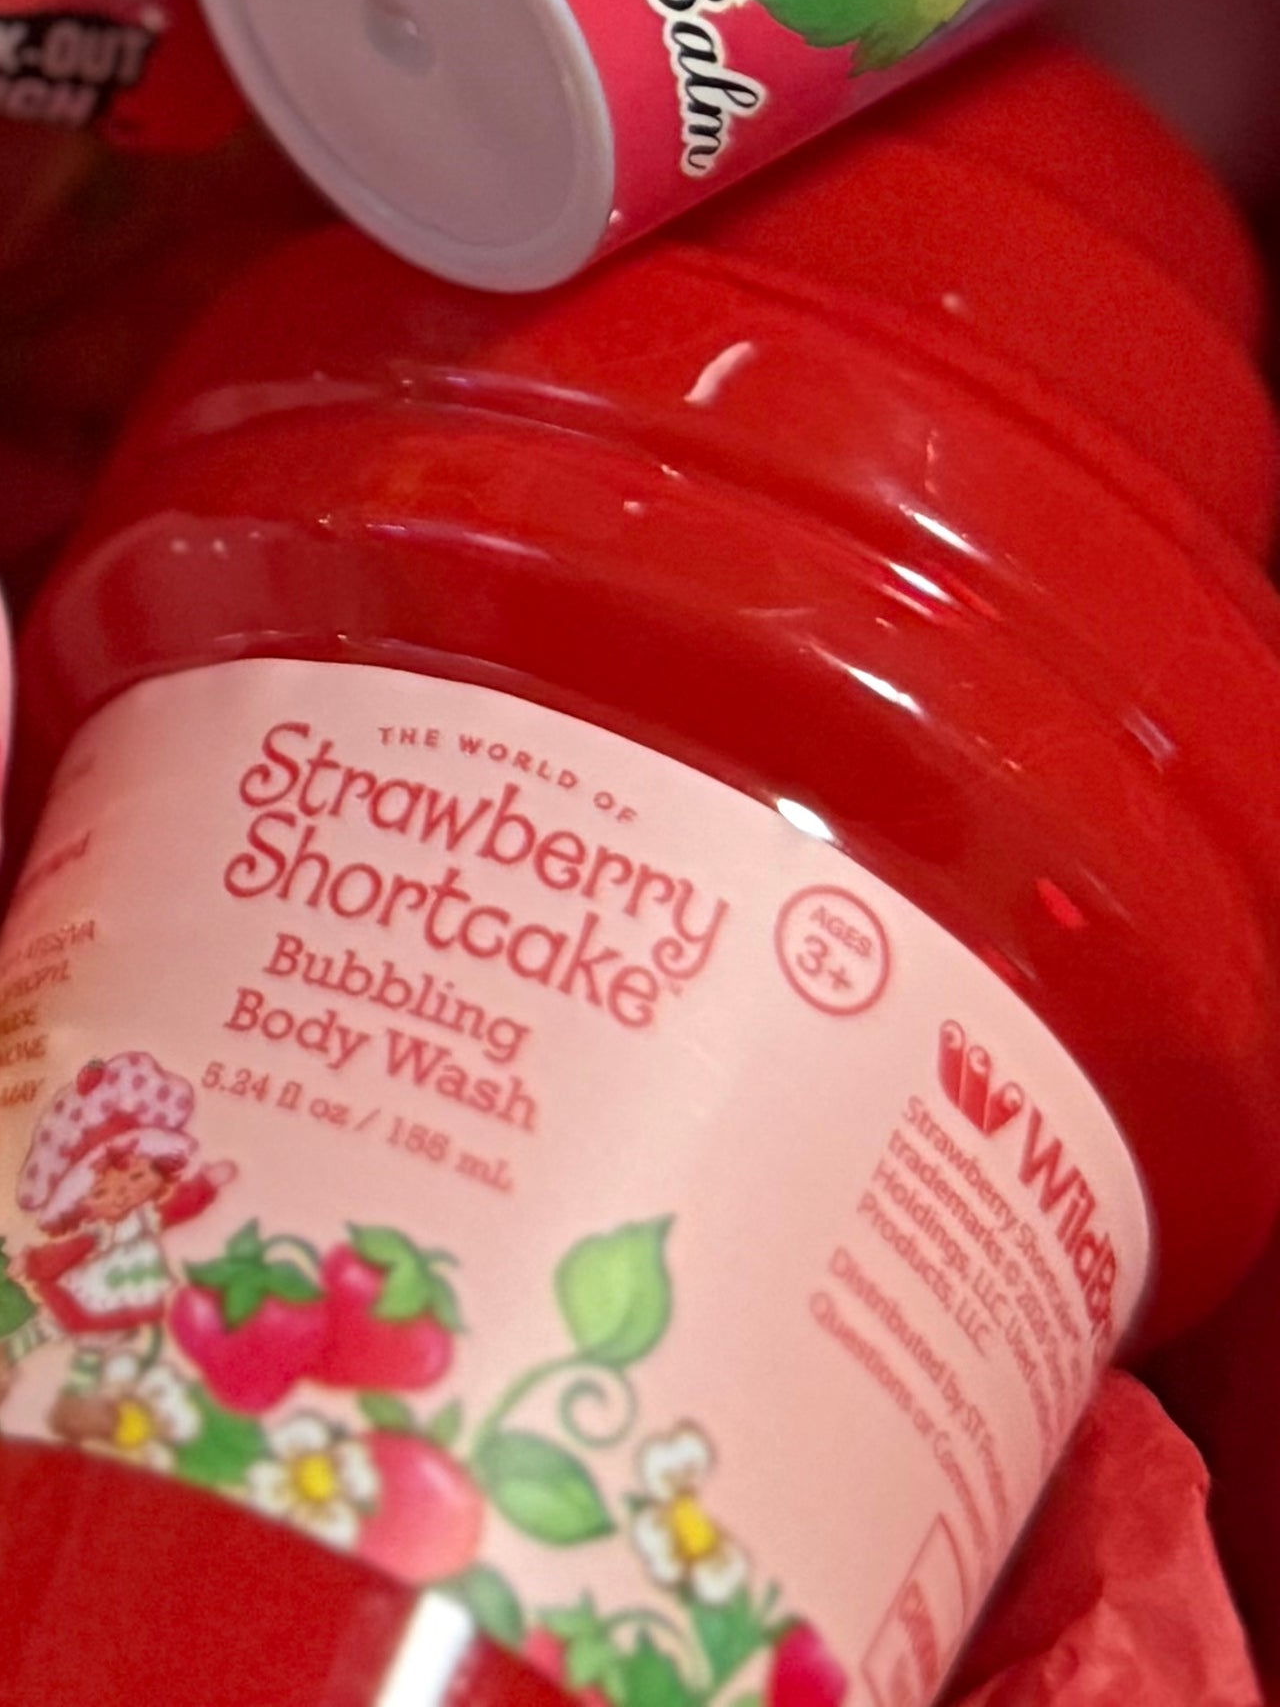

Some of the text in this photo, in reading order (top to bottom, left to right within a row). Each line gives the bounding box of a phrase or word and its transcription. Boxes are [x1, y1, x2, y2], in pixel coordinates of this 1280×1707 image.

[377, 726, 639, 825] THE WORLD OF
[238, 720, 731, 982] Strawberry
[222, 809, 662, 1031] Shortcake
[796, 933, 854, 994] 3+
[808, 904, 875, 961] AGES
[224, 988, 537, 1133] Body Wash
[262, 932, 532, 1067] Bubbling
[200, 1060, 270, 1104] 5.24
[309, 1098, 350, 1129] oz
[871, 1158, 972, 1284] Holdings,
[888, 1128, 1006, 1268] trademarks
[902, 1094, 1019, 1233] Strawberry
